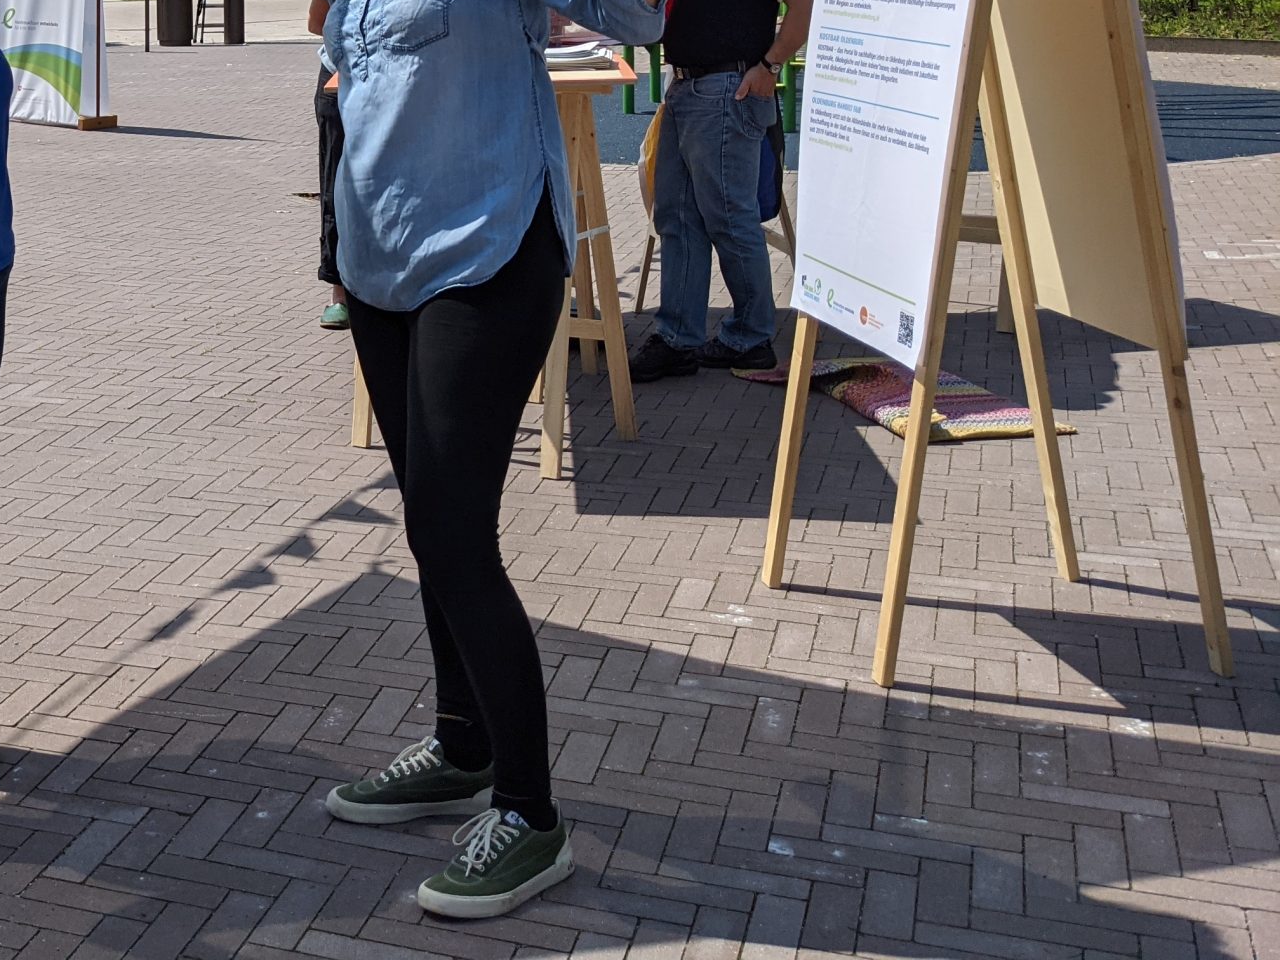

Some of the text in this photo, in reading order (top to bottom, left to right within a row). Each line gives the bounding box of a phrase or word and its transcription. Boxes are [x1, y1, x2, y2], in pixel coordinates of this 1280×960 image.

[819, 33, 864, 46] KOSTBAR OLDENBURG
[812, 97, 836, 107] OLDENBURG
